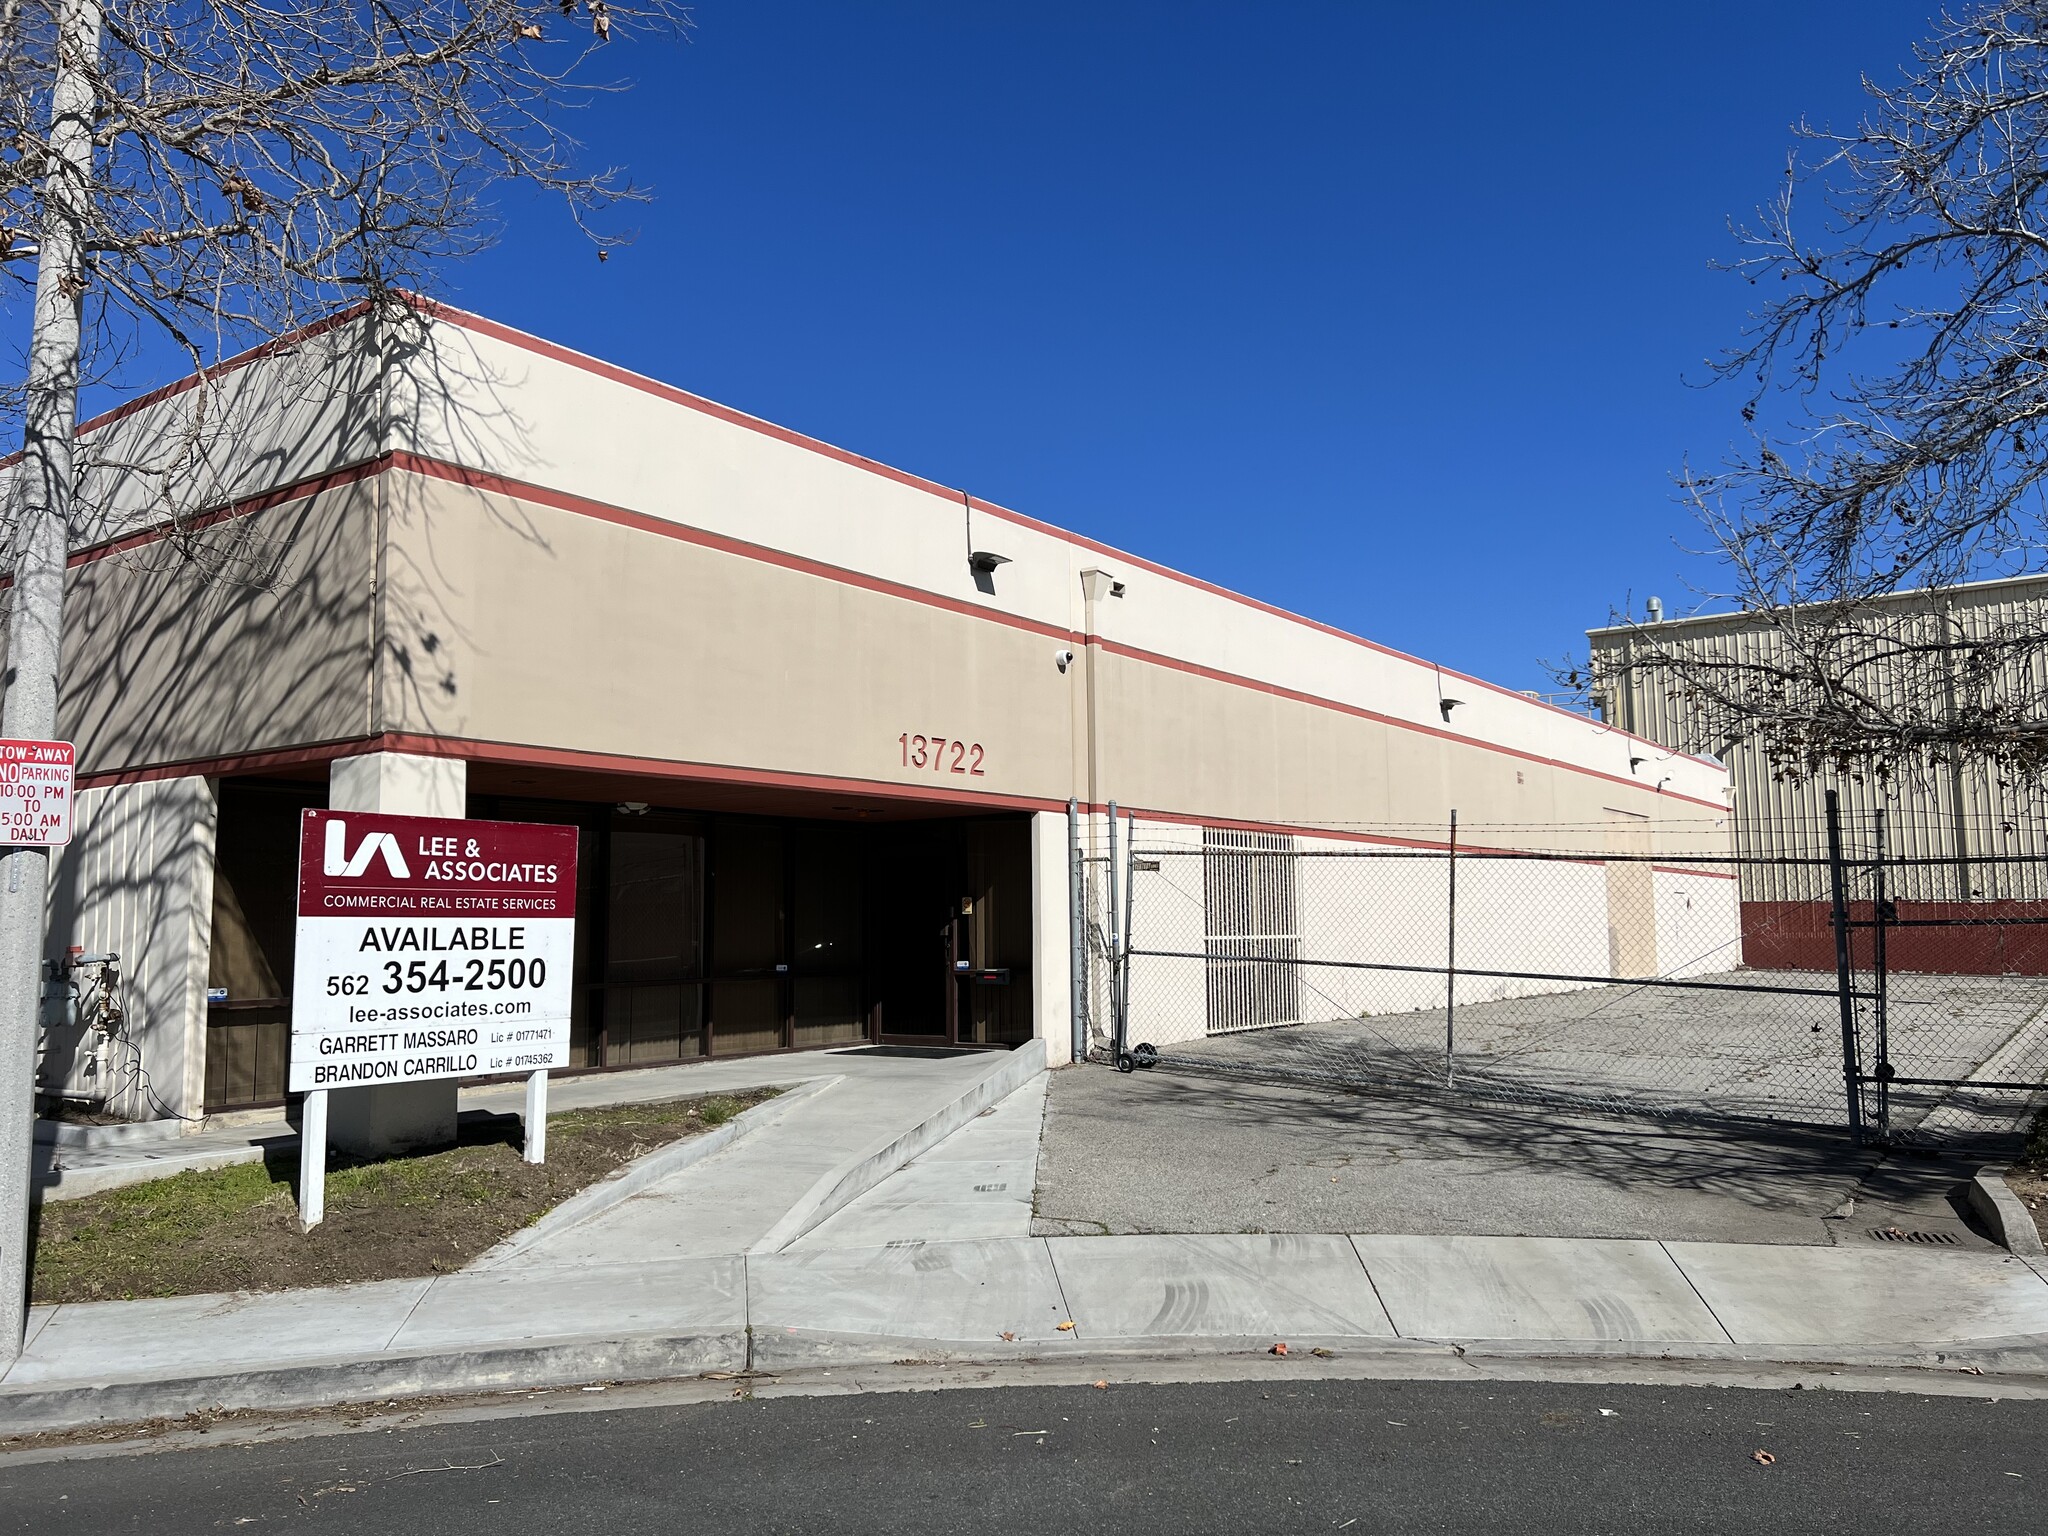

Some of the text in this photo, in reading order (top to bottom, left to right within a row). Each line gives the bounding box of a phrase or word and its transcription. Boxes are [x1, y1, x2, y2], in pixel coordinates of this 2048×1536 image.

[0, 745, 70, 762] TOW-AWAY
[899, 733, 985, 776] 13722
[0, 762, 69, 783] NO PARKING
[0, 784, 64, 799] 10:00 PM
[24, 799, 41, 813] TO
[1, 812, 61, 827] 5:00 AM
[11, 827, 48, 842] DAILY
[419, 836, 480, 858] LEE &
[424, 861, 557, 884] ASSOCIATES
[323, 895, 556, 910] COMMERCIAL REAL ESTATE SERVICES
[359, 926, 525, 952] AVAILABLE
[326, 958, 546, 996] 562 354-2500
[349, 1001, 532, 1023] lee-associates.com
[319, 1028, 478, 1055] GARRETT MASSARO
[490, 1028, 552, 1043] Lic # 01771471
[314, 1054, 477, 1084] BRANDON CARRILLO
[490, 1053, 553, 1069] Lic # 01745362
